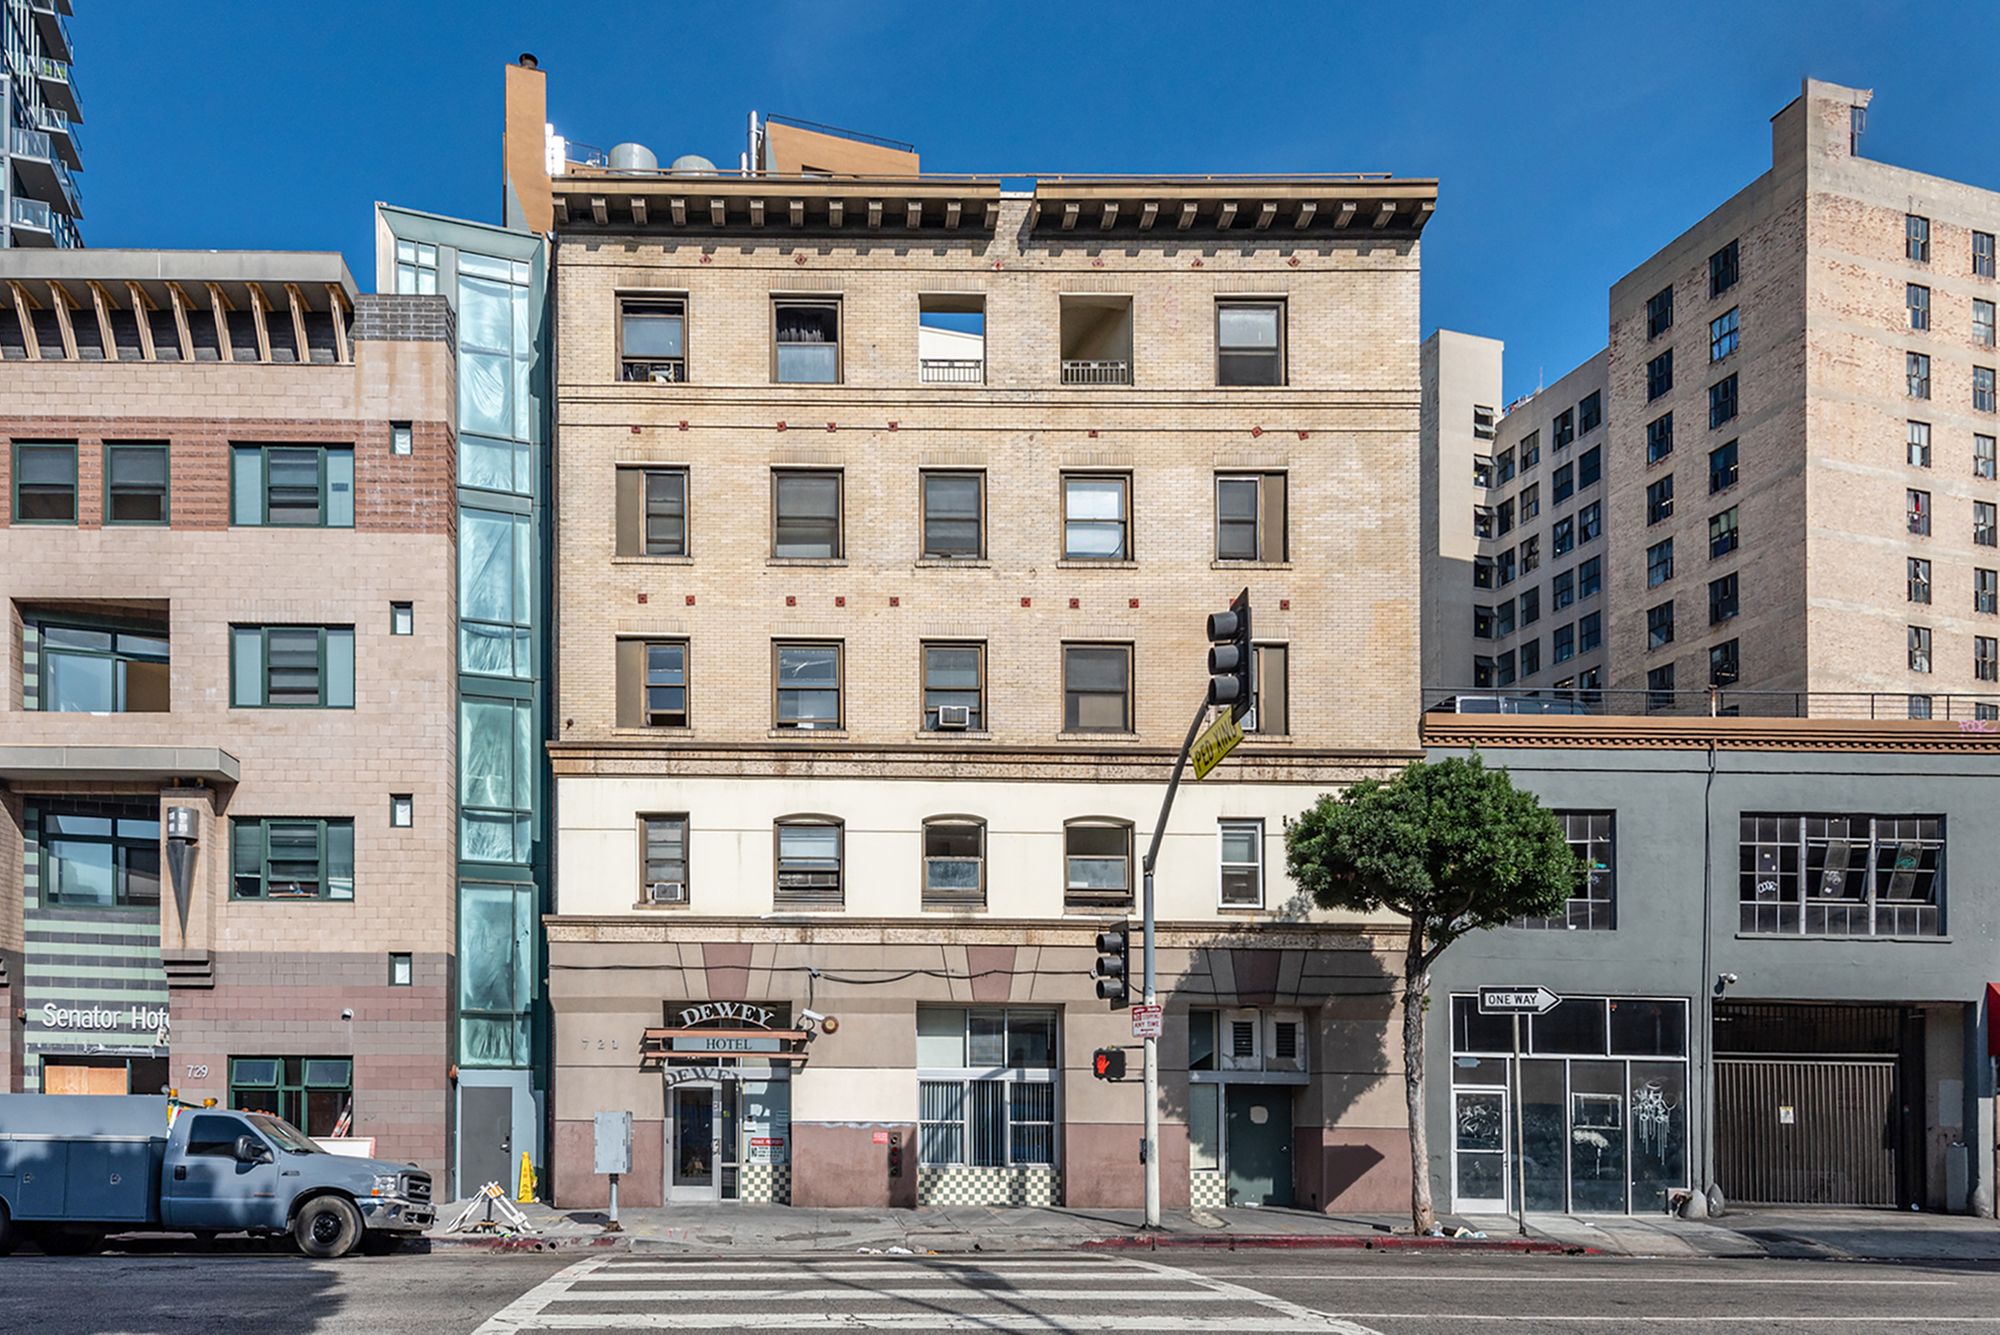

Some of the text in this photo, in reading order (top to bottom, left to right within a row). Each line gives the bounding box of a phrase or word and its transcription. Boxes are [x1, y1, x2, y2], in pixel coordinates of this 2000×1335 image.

[1195, 739, 1214, 772] PED
[1488, 994, 1537, 1005] ONE WAY
[42, 1002, 121, 1029] Senator
[679, 1001, 775, 1027] DEWEY
[706, 1038, 752, 1050] HOTEL
[187, 1064, 208, 1079] 729
